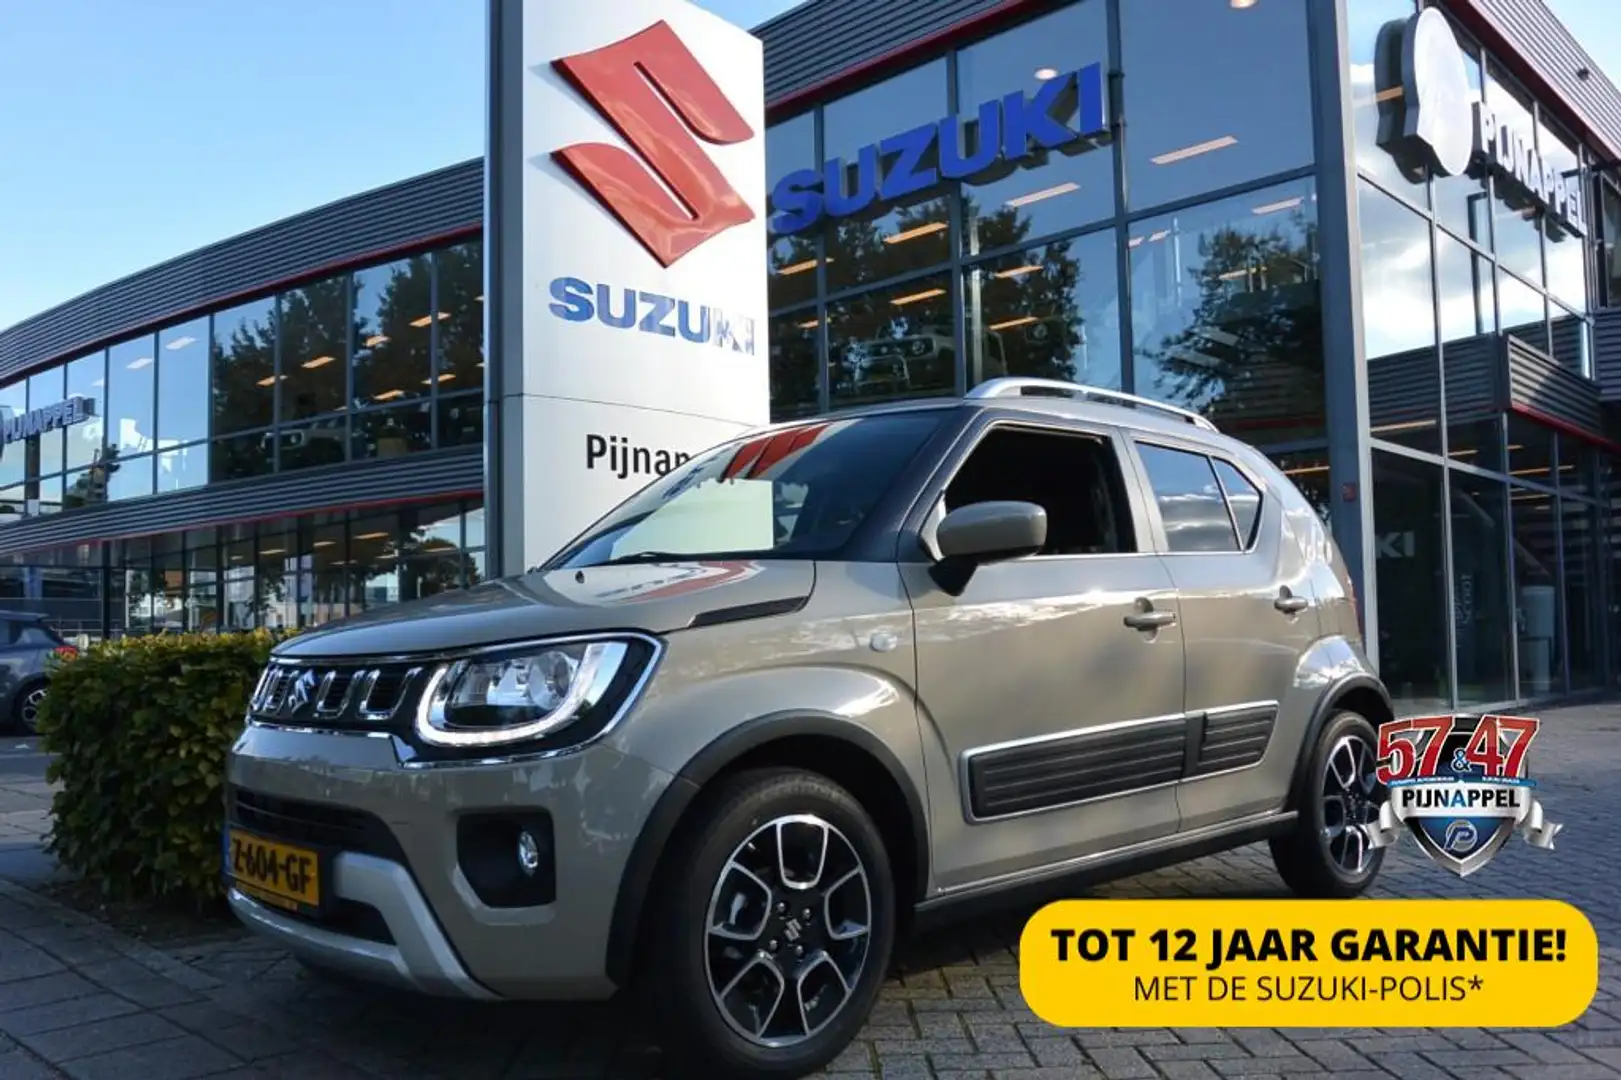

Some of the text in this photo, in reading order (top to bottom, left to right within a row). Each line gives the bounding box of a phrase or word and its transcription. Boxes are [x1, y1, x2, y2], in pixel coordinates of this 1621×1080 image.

[769, 62, 1103, 235] SUZUKI
[1477, 101, 1588, 237] PIJNAPPEL
[548, 276, 756, 356] SUZUKI
[232, 837, 313, 895] Z-604-GF
